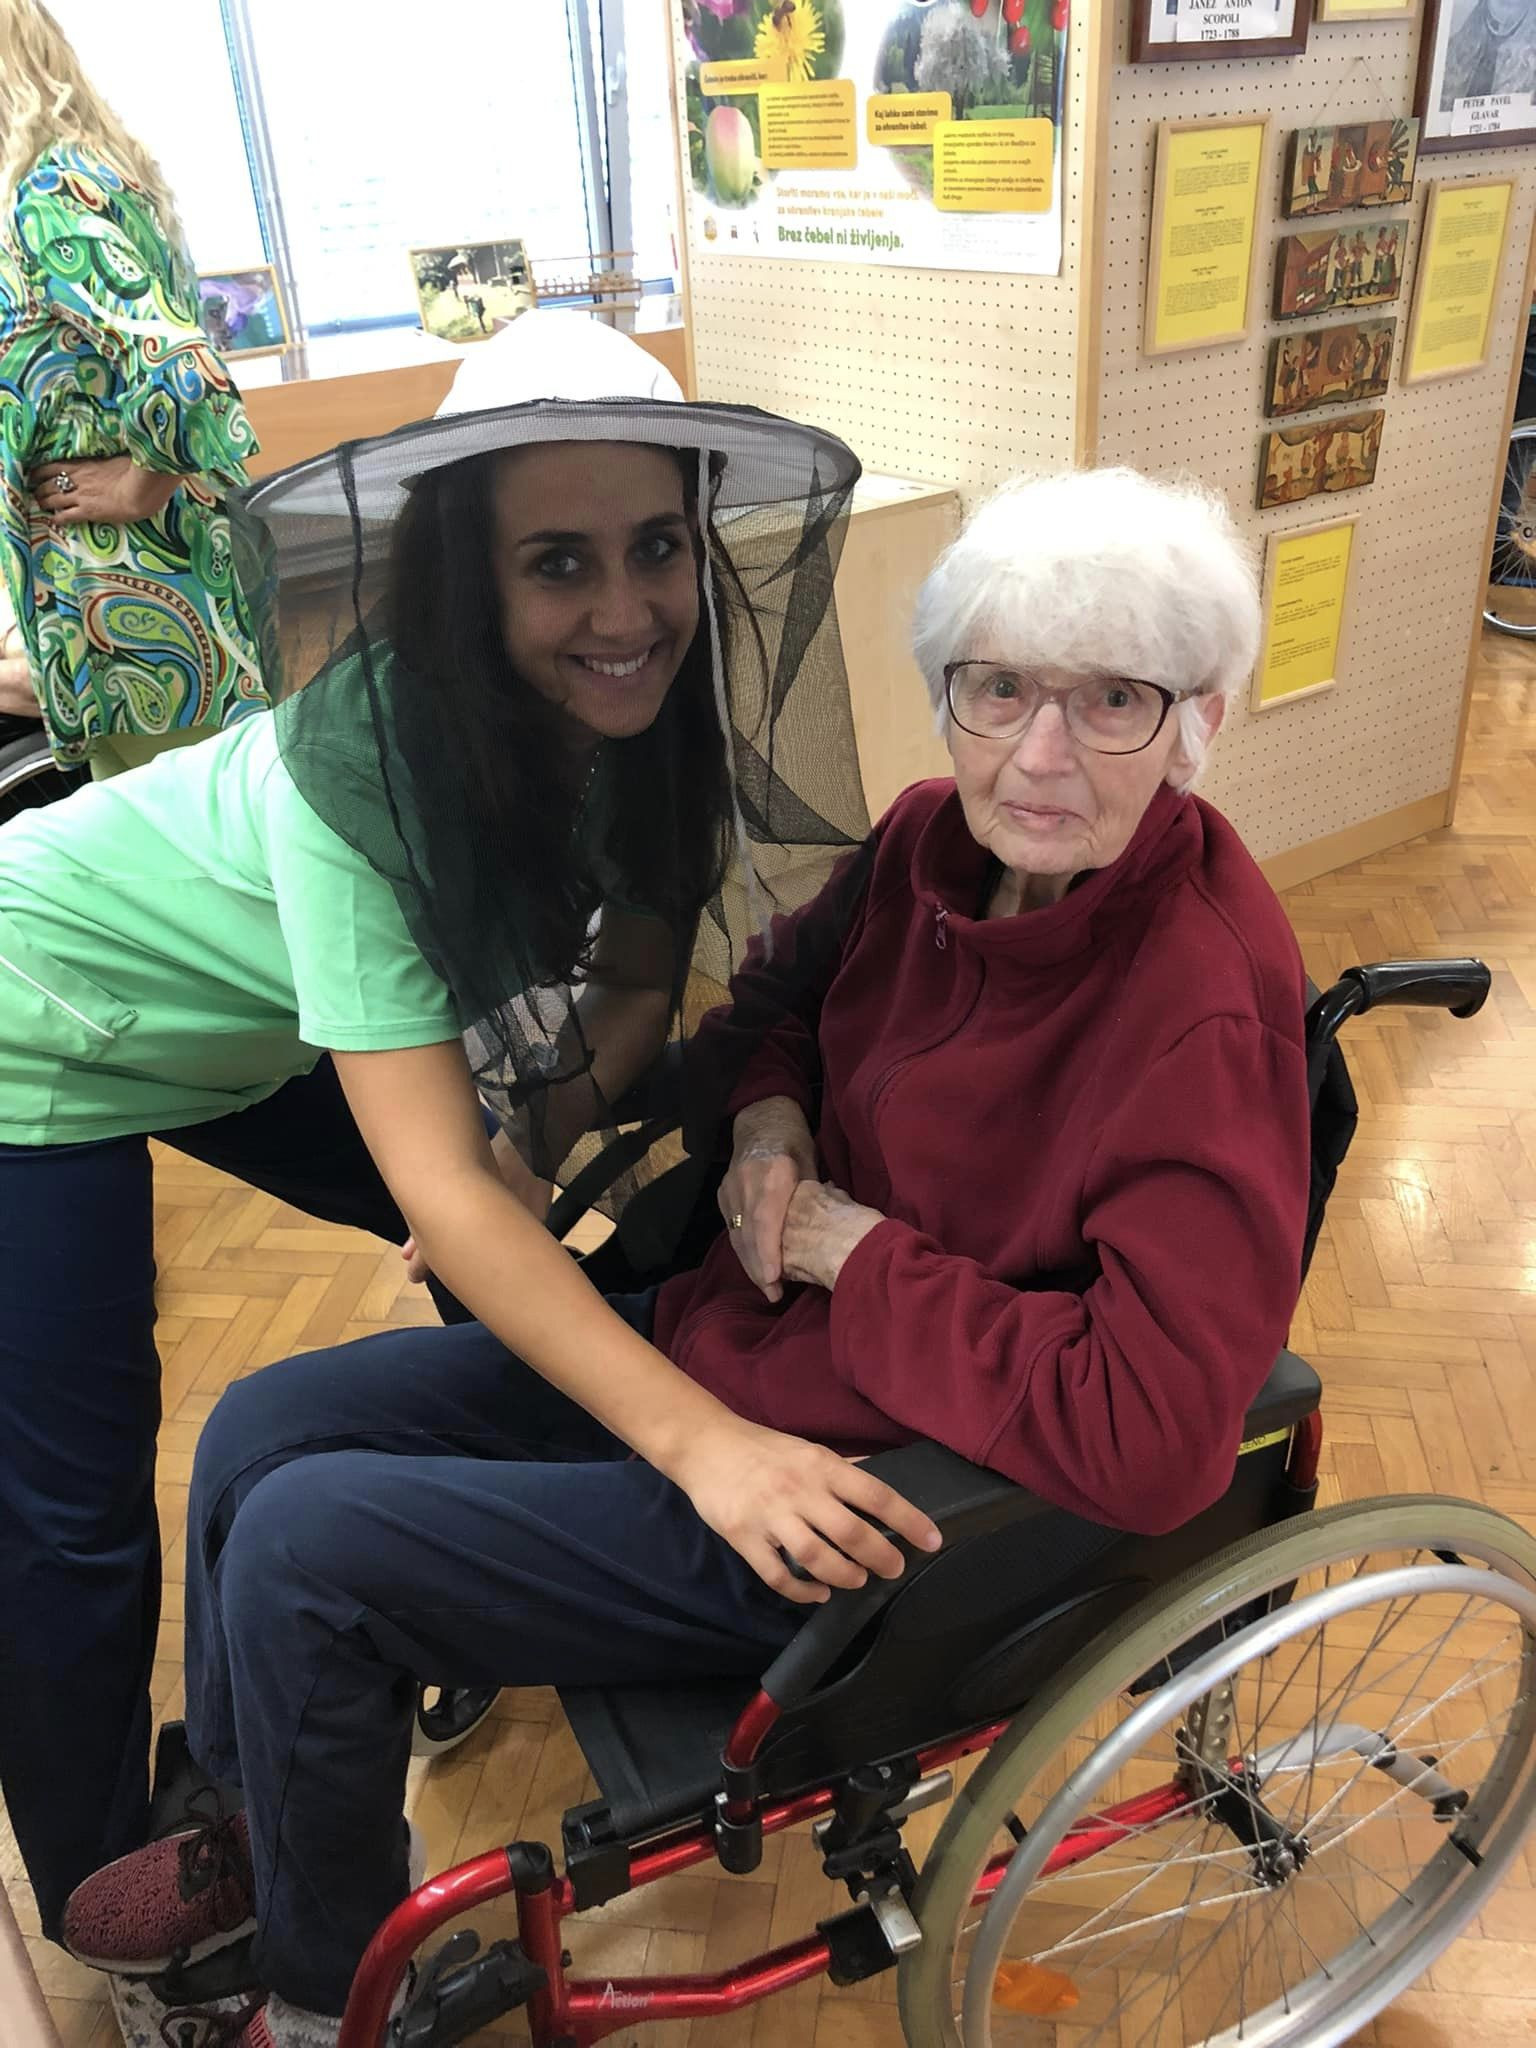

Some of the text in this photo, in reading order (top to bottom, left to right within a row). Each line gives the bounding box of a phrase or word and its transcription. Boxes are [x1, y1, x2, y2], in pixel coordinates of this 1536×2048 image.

[1202, 13, 1240, 24] SCOPOLI
[1201, 29, 1217, 40] 1723
[1463, 96, 1511, 108] PETER PAVEL
[1471, 109, 1499, 120] GLAVAR
[778, 225, 904, 252] Brez čebel ni življenja.
